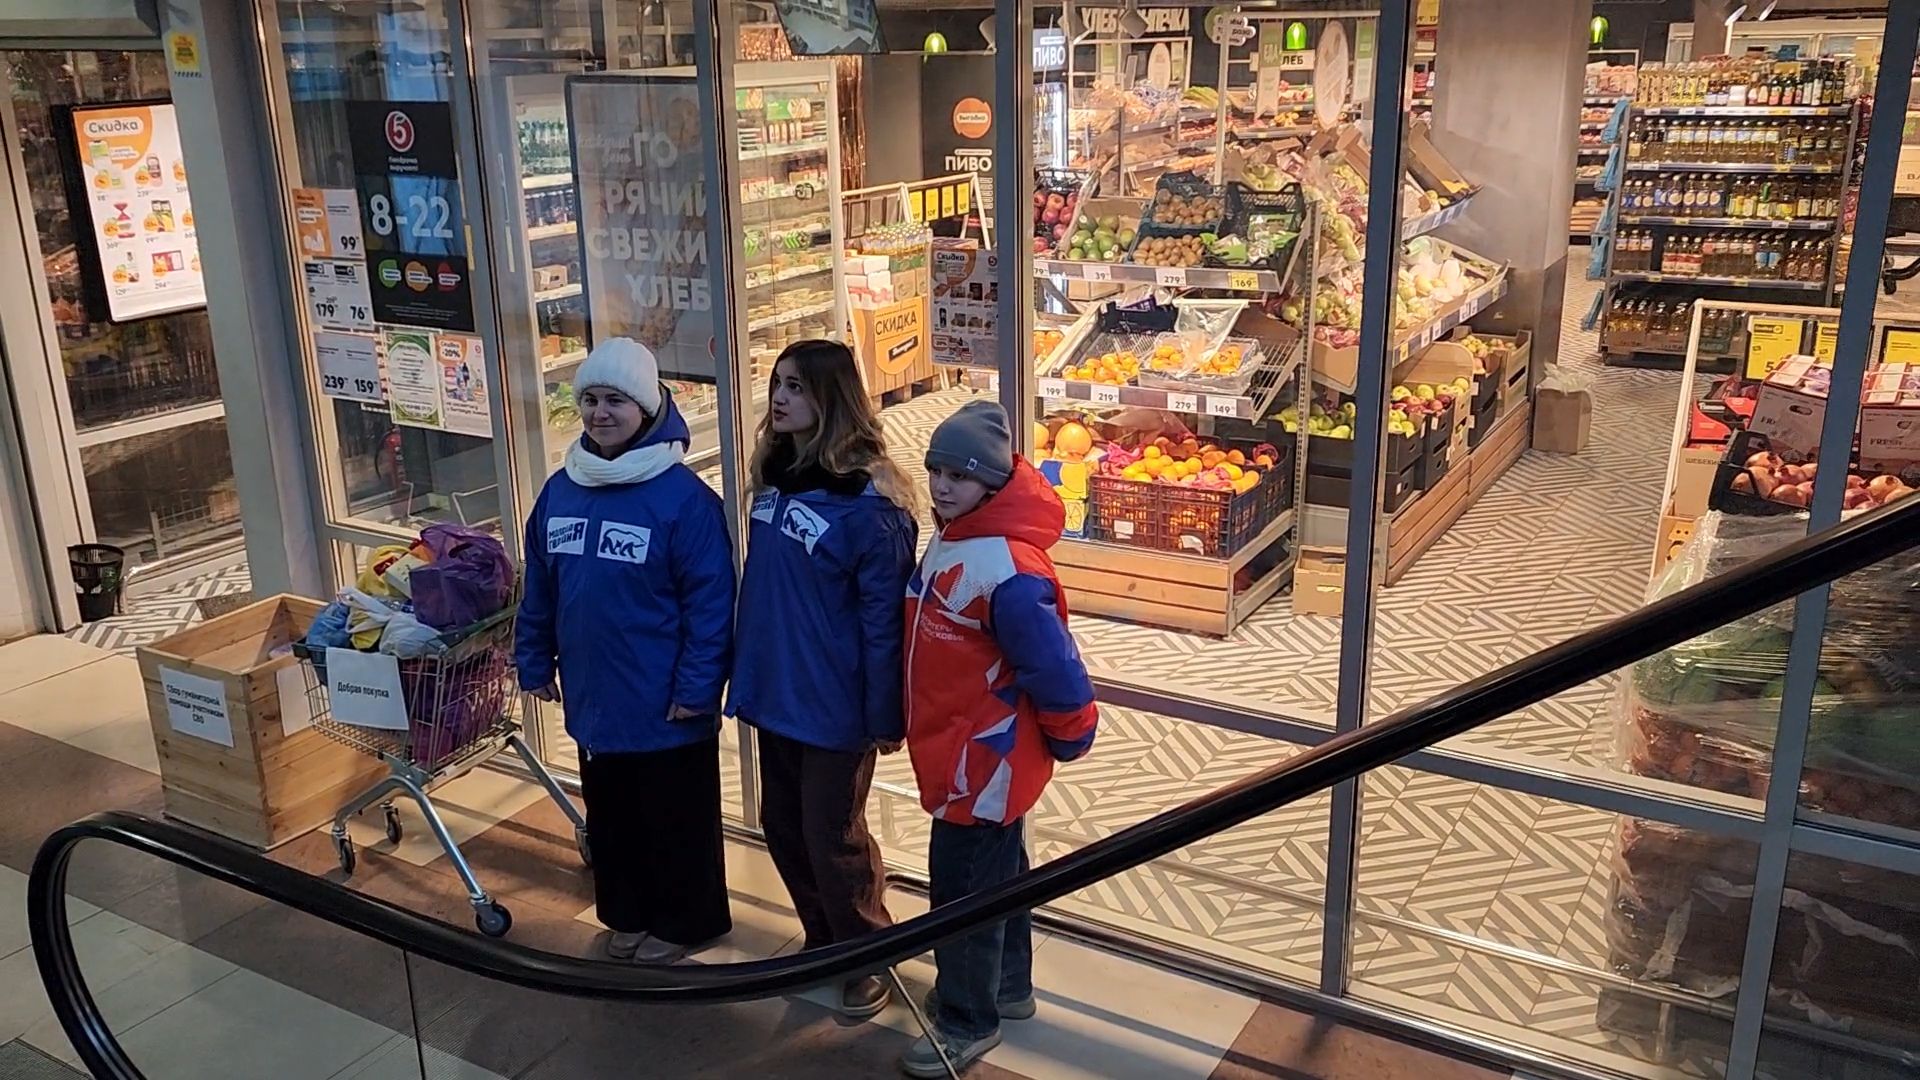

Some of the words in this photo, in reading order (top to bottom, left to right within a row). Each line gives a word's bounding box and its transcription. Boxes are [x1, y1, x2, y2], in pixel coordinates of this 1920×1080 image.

[1033, 46, 1066, 67] ПИВО
[88, 119, 139, 134] Скидка
[632, 131, 679, 168] ГО
[945, 155, 992, 172] ПИВО
[370, 193, 453, 238] 8-22
[341, 235, 356, 250] 99
[1164, 275, 1181, 285] 279
[1234, 279, 1252, 288] 169
[625, 273, 712, 312] ХЛЕБ
[316, 303, 335, 317] 179
[350, 305, 365, 320] 76
[875, 310, 918, 336] СКИДКА
[324, 374, 345, 389] 239
[354, 378, 374, 393] 159
[1046, 387, 1061, 396] 199
[1099, 392, 1114, 402] 219
[1175, 401, 1192, 410] 279
[1215, 405, 1231, 413] 149
[337, 681, 362, 695] Добрая
[363, 686, 390, 699] покупка
[192, 713, 205, 725] СВО
